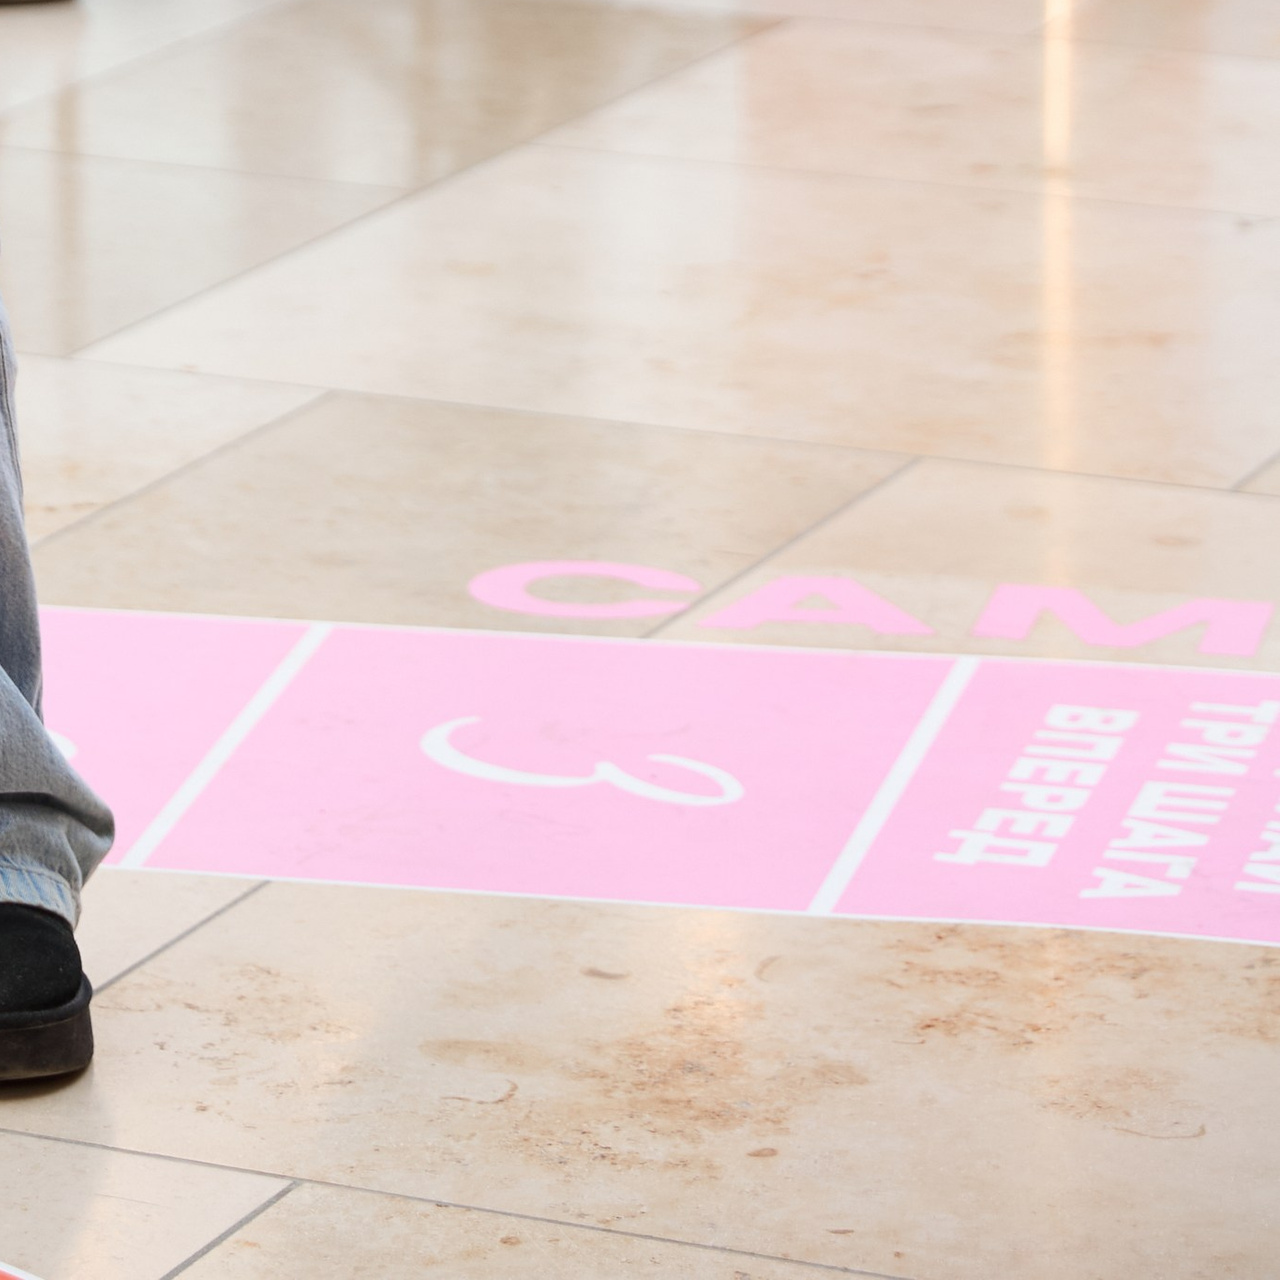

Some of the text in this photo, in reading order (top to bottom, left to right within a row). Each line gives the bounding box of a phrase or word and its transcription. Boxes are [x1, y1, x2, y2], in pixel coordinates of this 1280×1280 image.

[419, 715, 745, 807] 3
[932, 703, 1143, 868] ВПЕРЕД
[1077, 699, 1280, 899] ТРИ ШАГА
